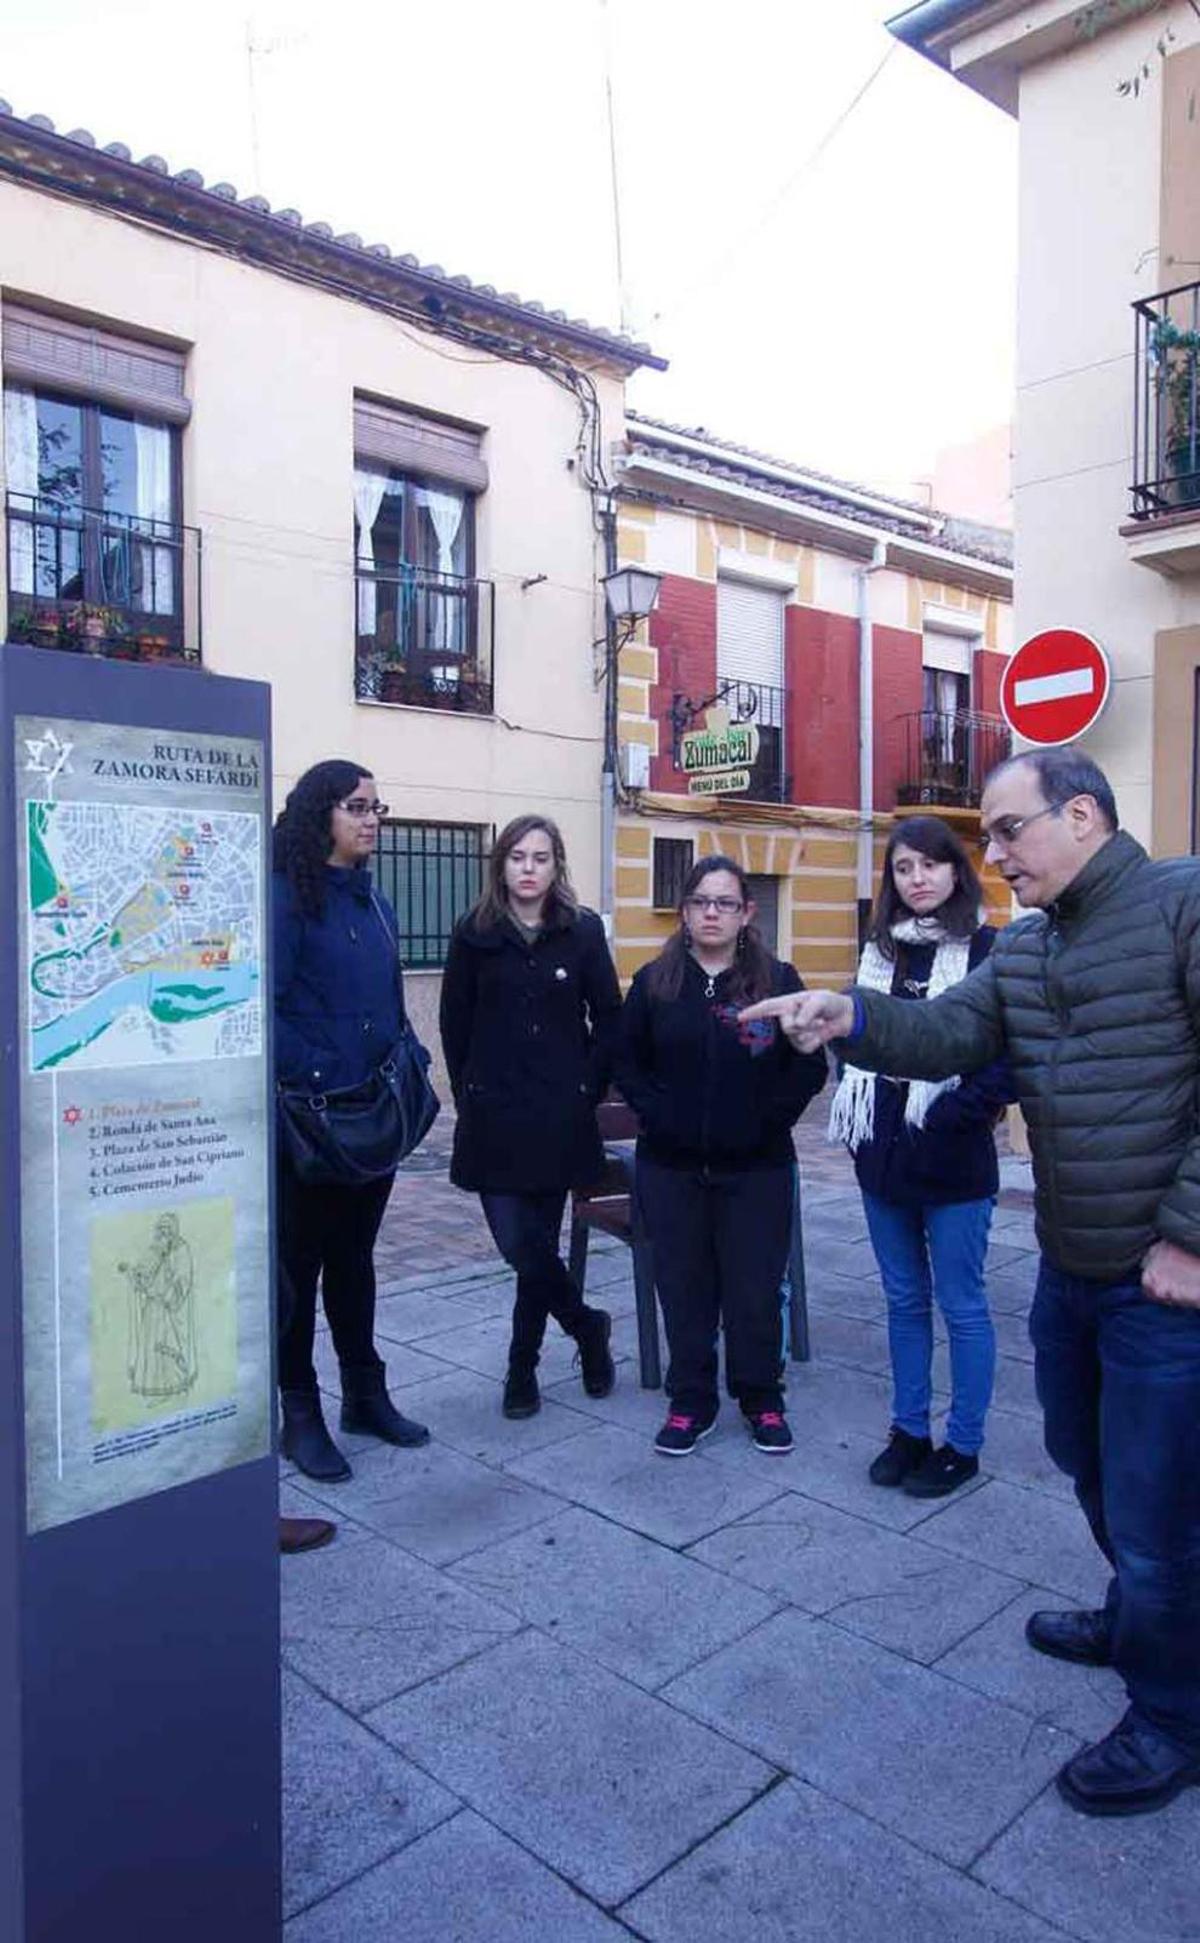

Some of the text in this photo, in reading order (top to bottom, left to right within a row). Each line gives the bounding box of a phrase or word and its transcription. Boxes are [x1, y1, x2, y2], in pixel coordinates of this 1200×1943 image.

[153, 744, 258, 768] RUTA DE LA
[684, 732, 751, 769] Zumacal
[93, 759, 259, 789] ZAMORA SEFARDÍ
[715, 778, 729, 791] DEL
[102, 1121, 142, 1138] Ronda
[144, 1120, 158, 1133] de
[161, 1117, 192, 1129] Santa
[196, 1115, 217, 1125] Ana
[103, 1143, 135, 1157] Plaza
[137, 1139, 151, 1152] de
[154, 1139, 174, 1149] San
[159, 1156, 172, 1169] de
[175, 1154, 195, 1164] San
[103, 1177, 172, 1196] Cementerio
